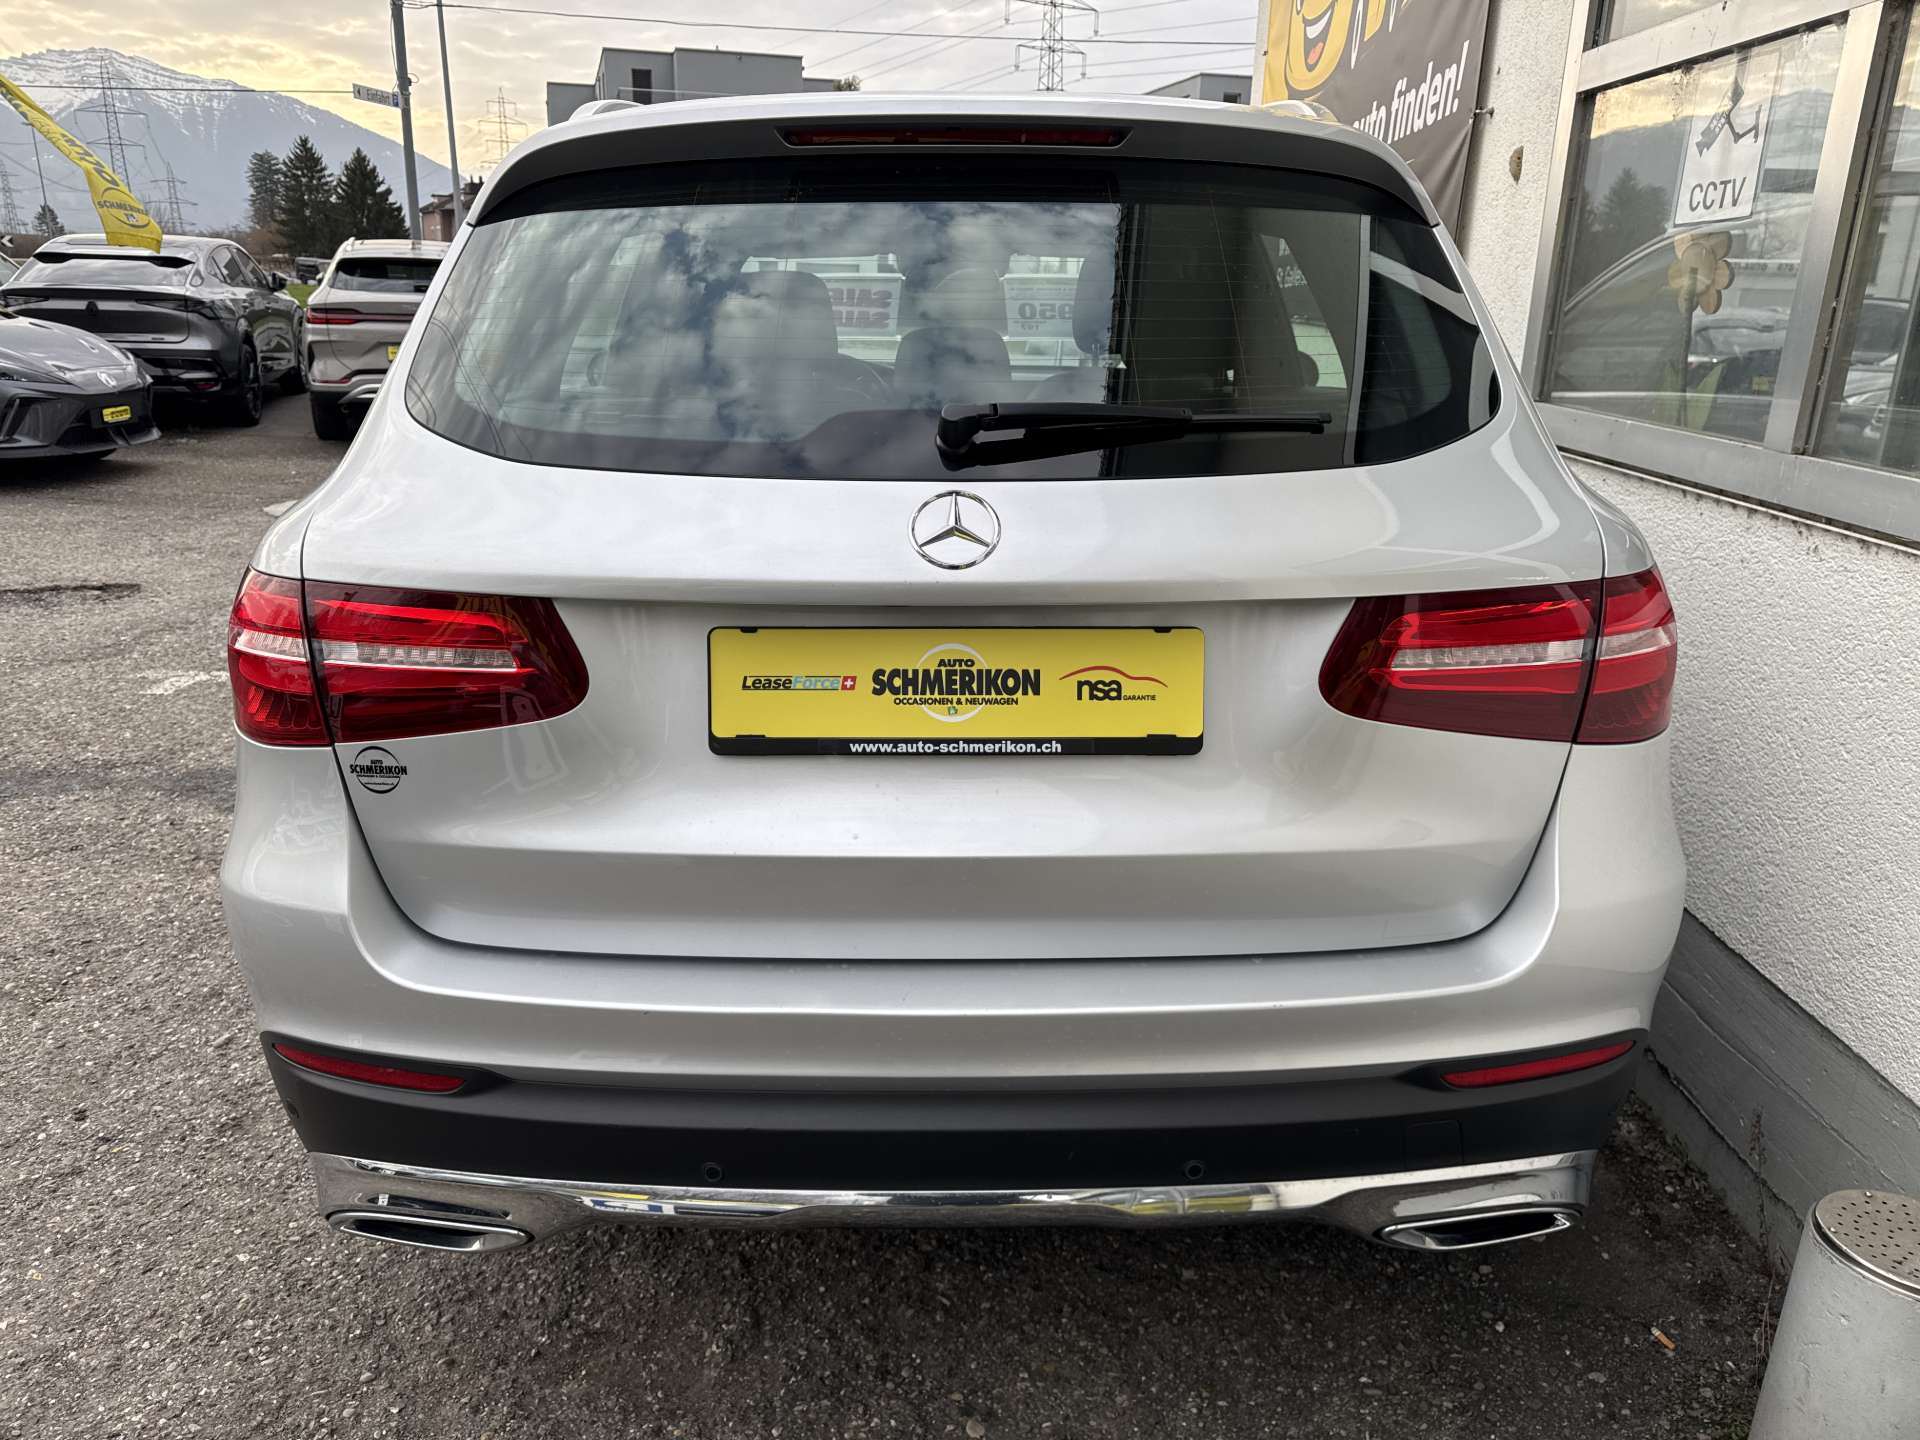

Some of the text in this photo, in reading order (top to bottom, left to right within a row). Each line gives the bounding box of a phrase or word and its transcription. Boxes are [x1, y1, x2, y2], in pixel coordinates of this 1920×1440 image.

[1353, 40, 1470, 144] to finden!
[1688, 176, 1747, 212] CCTV
[938, 658, 976, 668] AUTO
[741, 675, 841, 690] LeaseForce
[871, 668, 1041, 697] SCHMERIKON
[1076, 679, 1122, 701] nsa
[893, 697, 1019, 706] OCCASIONEN & NEUWAGEN
[849, 740, 1063, 754] www.auto-schmerikon.ch
[349, 764, 408, 776] SCHMERIKON
